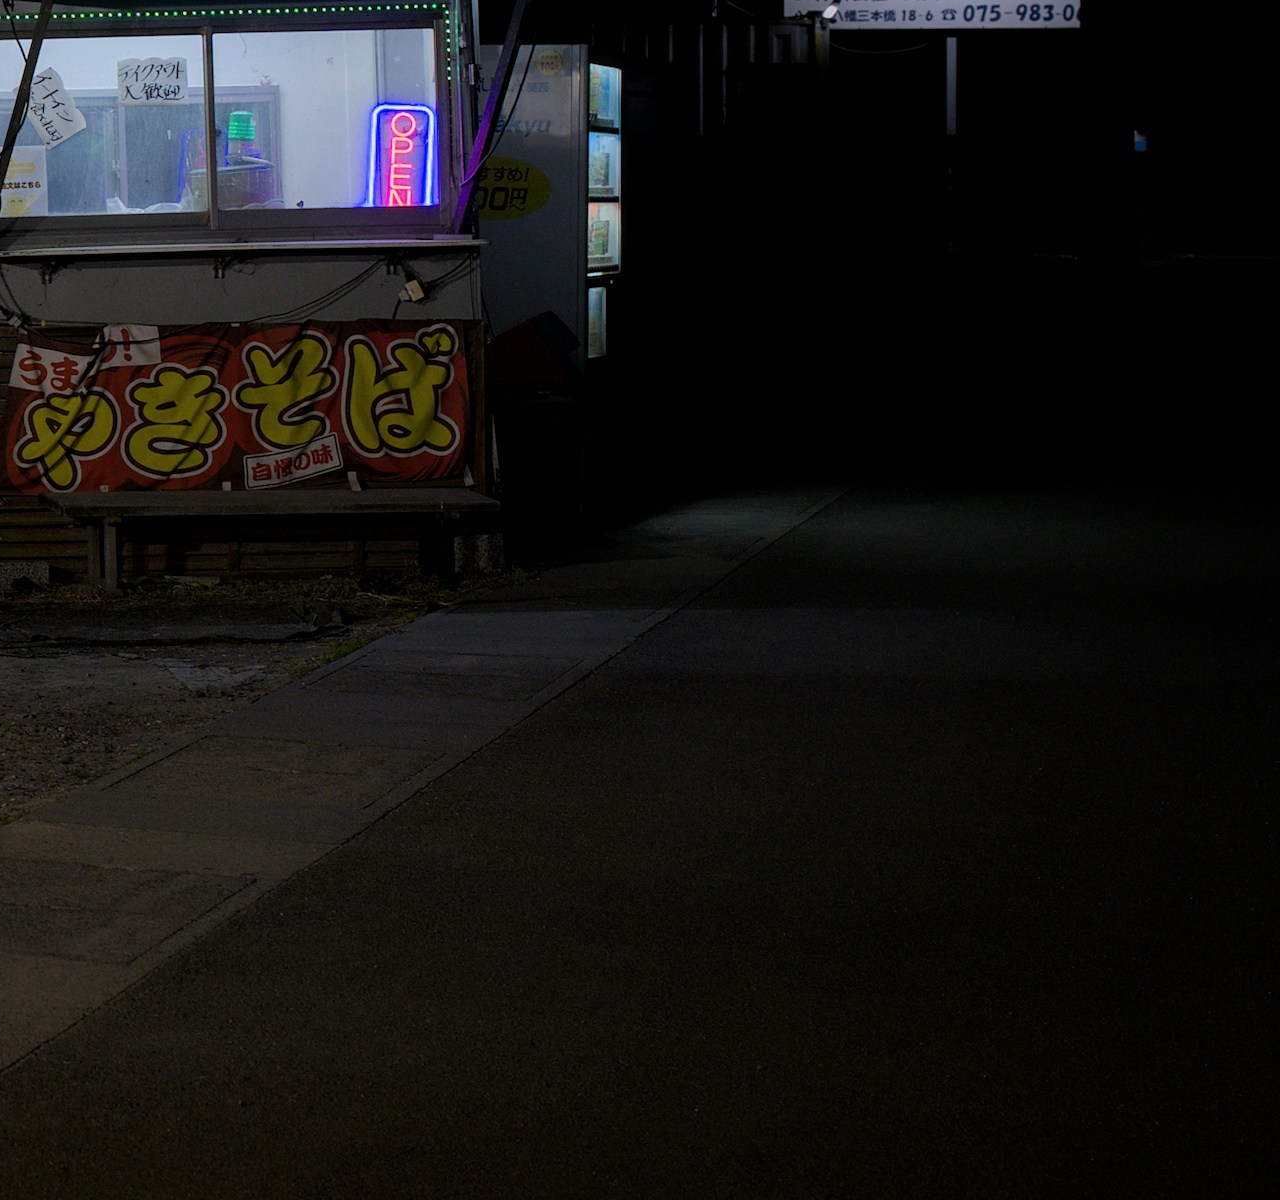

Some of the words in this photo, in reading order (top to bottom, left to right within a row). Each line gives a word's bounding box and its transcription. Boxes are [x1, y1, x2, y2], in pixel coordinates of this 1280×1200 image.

[118, 61, 184, 83] テイクアウト
[388, 112, 417, 206] OPEN
[13, 322, 462, 493] やきそば
[251, 443, 334, 481] 自慢の味
